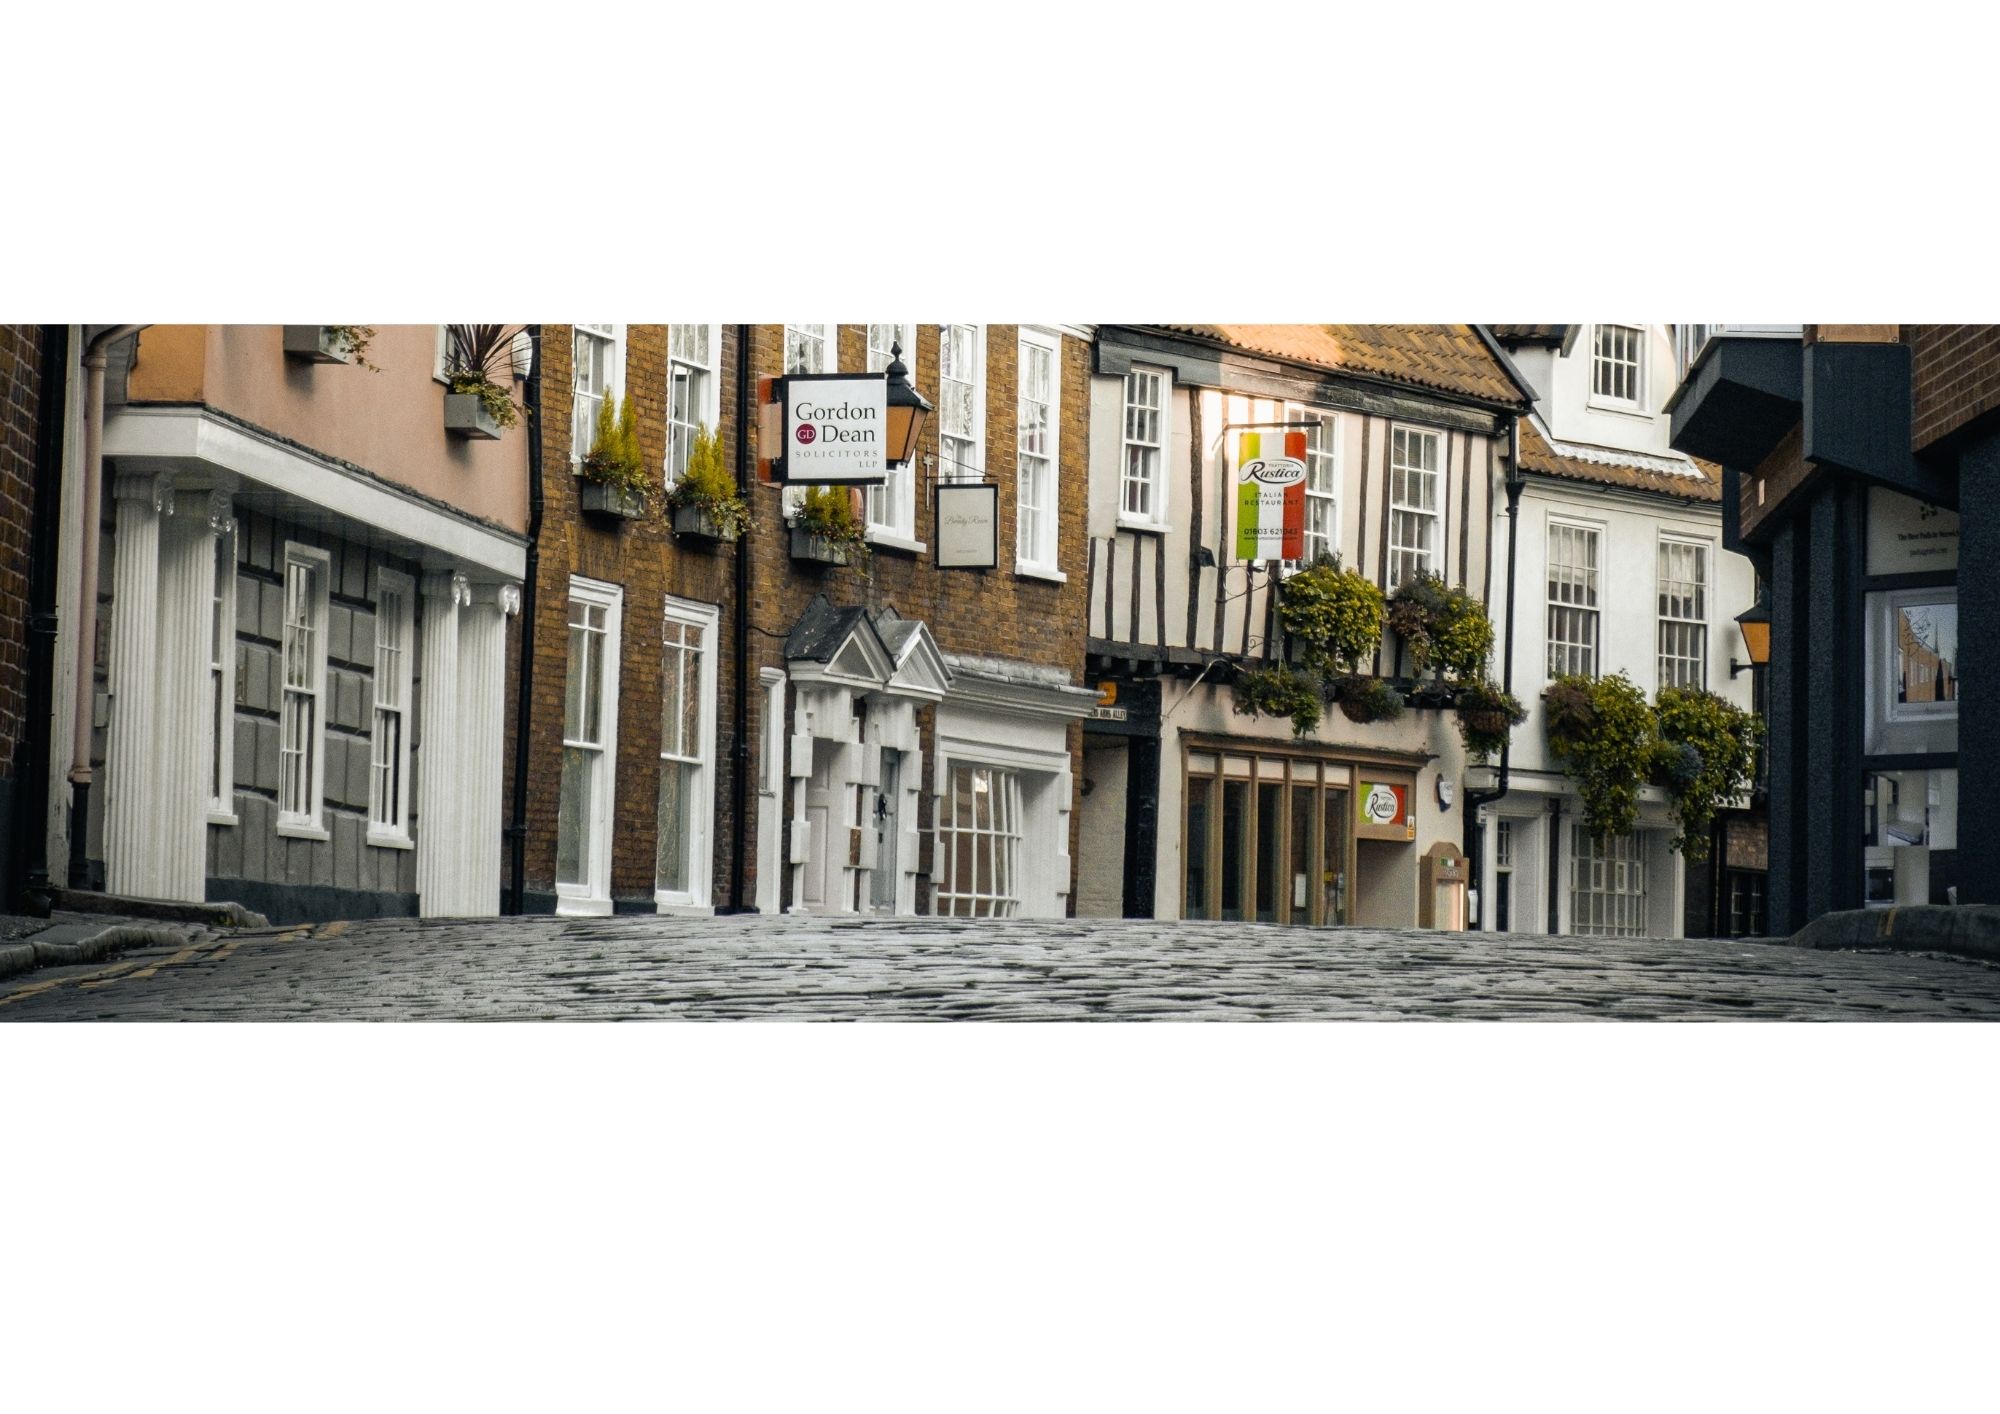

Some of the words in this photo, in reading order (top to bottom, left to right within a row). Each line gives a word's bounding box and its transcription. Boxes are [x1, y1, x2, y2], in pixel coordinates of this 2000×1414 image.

[795, 402, 876, 420] Gordon
[797, 429, 815, 439] GD
[821, 424, 875, 443] Dean
[795, 450, 878, 458] SOLICITORS
[1241, 461, 1301, 482] Rustica
[1367, 793, 1395, 815] Rustica
